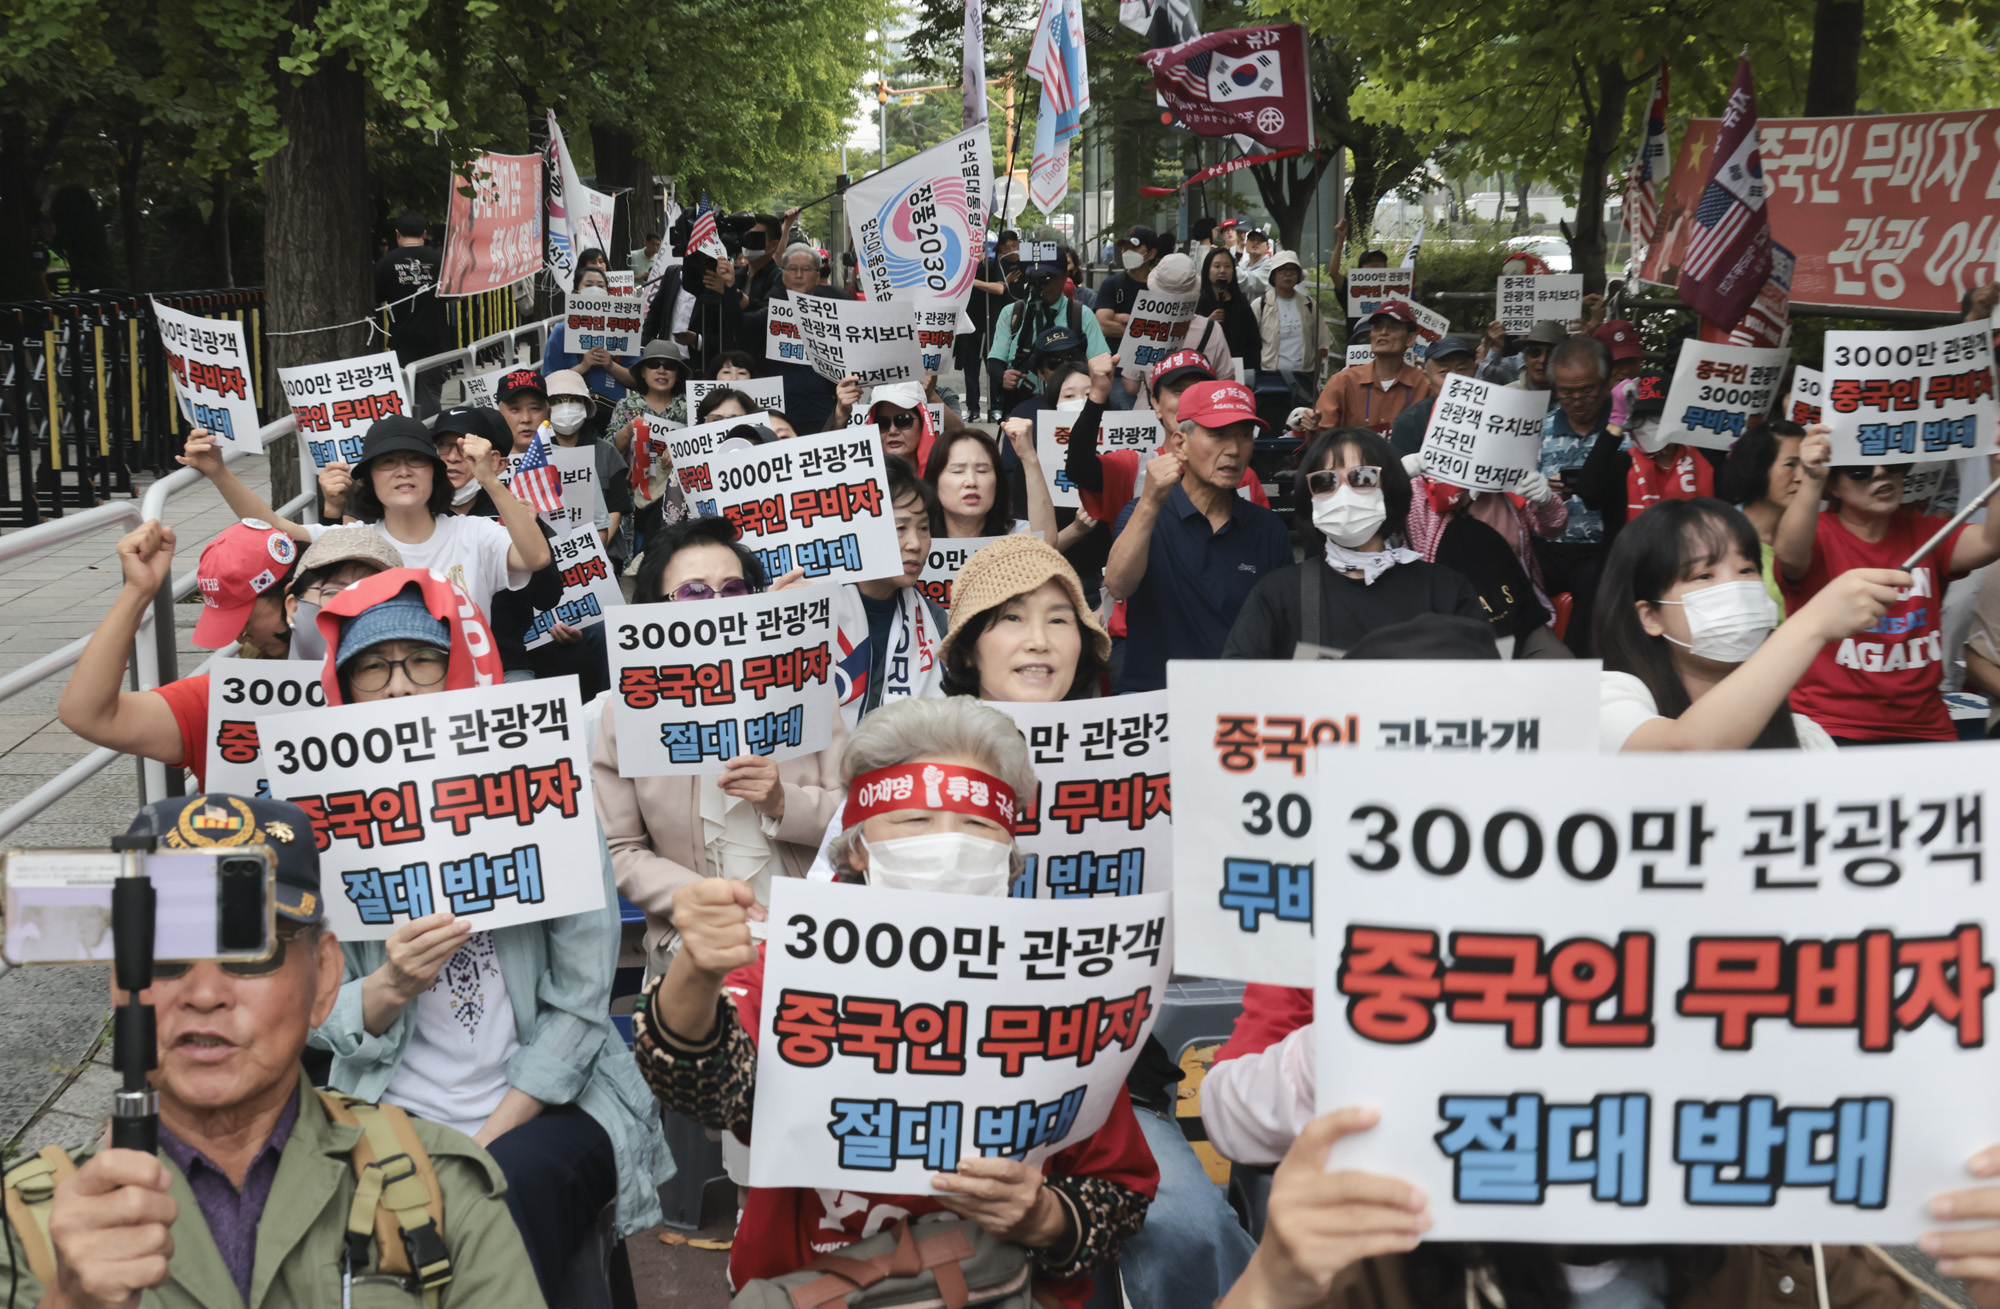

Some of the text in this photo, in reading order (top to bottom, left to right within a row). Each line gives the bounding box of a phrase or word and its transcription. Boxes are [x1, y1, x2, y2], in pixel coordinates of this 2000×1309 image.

[1851, 114, 1989, 205] 무비자
[908, 184, 948, 292] 장풍2030
[1828, 216, 1930, 301] 관광
[1351, 273, 1387, 281] 3000만
[1503, 276, 1535, 289] 중국인
[569, 300, 641, 314] 3000만 관광객
[796, 297, 839, 320] 중국인
[1137, 298, 1179, 316] 3000만
[1502, 304, 1534, 316] 자국민
[1503, 289, 1580, 303] 관광객 유치보다
[568, 314, 640, 333] 중국인 무비자
[801, 316, 915, 344] 관광객 유치보다
[925, 311, 956, 326] 관광객
[1129, 317, 1172, 342] 중국인
[189, 327, 239, 358] 관광객
[579, 335, 628, 352] 절대 반대
[779, 342, 804, 360] 절대
[807, 338, 845, 364] 자국민
[918, 330, 954, 349] 무비자
[1350, 350, 1376, 360] 3000
[1834, 331, 1989, 369] 3000만 관광객
[189, 358, 247, 401] 무비자
[336, 362, 395, 391] 관광객
[467, 377, 487, 394] 중국인
[507, 371, 538, 379] STOP
[507, 380, 541, 390] STEAL
[815, 358, 911, 386] 안전이 먼저다!
[1696, 360, 1748, 385] 중국인
[1449, 378, 1489, 405] 중국인
[1831, 376, 1922, 415] 중국인
[1925, 366, 1994, 410] 무비자
[194, 402, 235, 441] 반대
[332, 390, 403, 428] 무비자
[1441, 402, 1483, 430] 관광객
[1681, 405, 1746, 438] 무비자
[670, 433, 713, 460] 3000만
[1108, 426, 1157, 446] 관광객
[1431, 425, 1476, 454] 자국민
[1857, 413, 1977, 458] 절대 반대
[308, 435, 366, 468] 절대 반
[717, 439, 875, 493] 3000만 관광객
[1424, 450, 1469, 480] 안전이
[677, 462, 713, 494] 중국인
[723, 477, 884, 543] 중국인 무비자
[795, 533, 863, 578] 반대
[201, 578, 219, 591] THE
[556, 591, 602, 627] 반대
[618, 597, 830, 651] 3000만 관광객
[619, 640, 831, 710] 중국인 무비자
[222, 676, 325, 707] 3000
[274, 715, 437, 775] 3000만
[448, 697, 571, 757] 관광객
[660, 704, 804, 764] 절대 반대
[430, 757, 583, 836] 무비자
[859, 773, 914, 808] 이재명
[946, 775, 990, 808] 투쟁
[1347, 801, 1716, 891] 3000만
[1742, 792, 1986, 889] 관광객
[341, 843, 546, 925] 절대 반대
[1046, 847, 1146, 900] 반대
[1219, 856, 1314, 937] 무비
[784, 914, 1166, 980] 3000만 관광객
[1337, 922, 1996, 1053] 중국인 무비자
[773, 985, 1153, 1077] 중국인 무비자
[828, 1084, 1088, 1172] 절대 반대
[1434, 1091, 1894, 1210] 절대 반대
